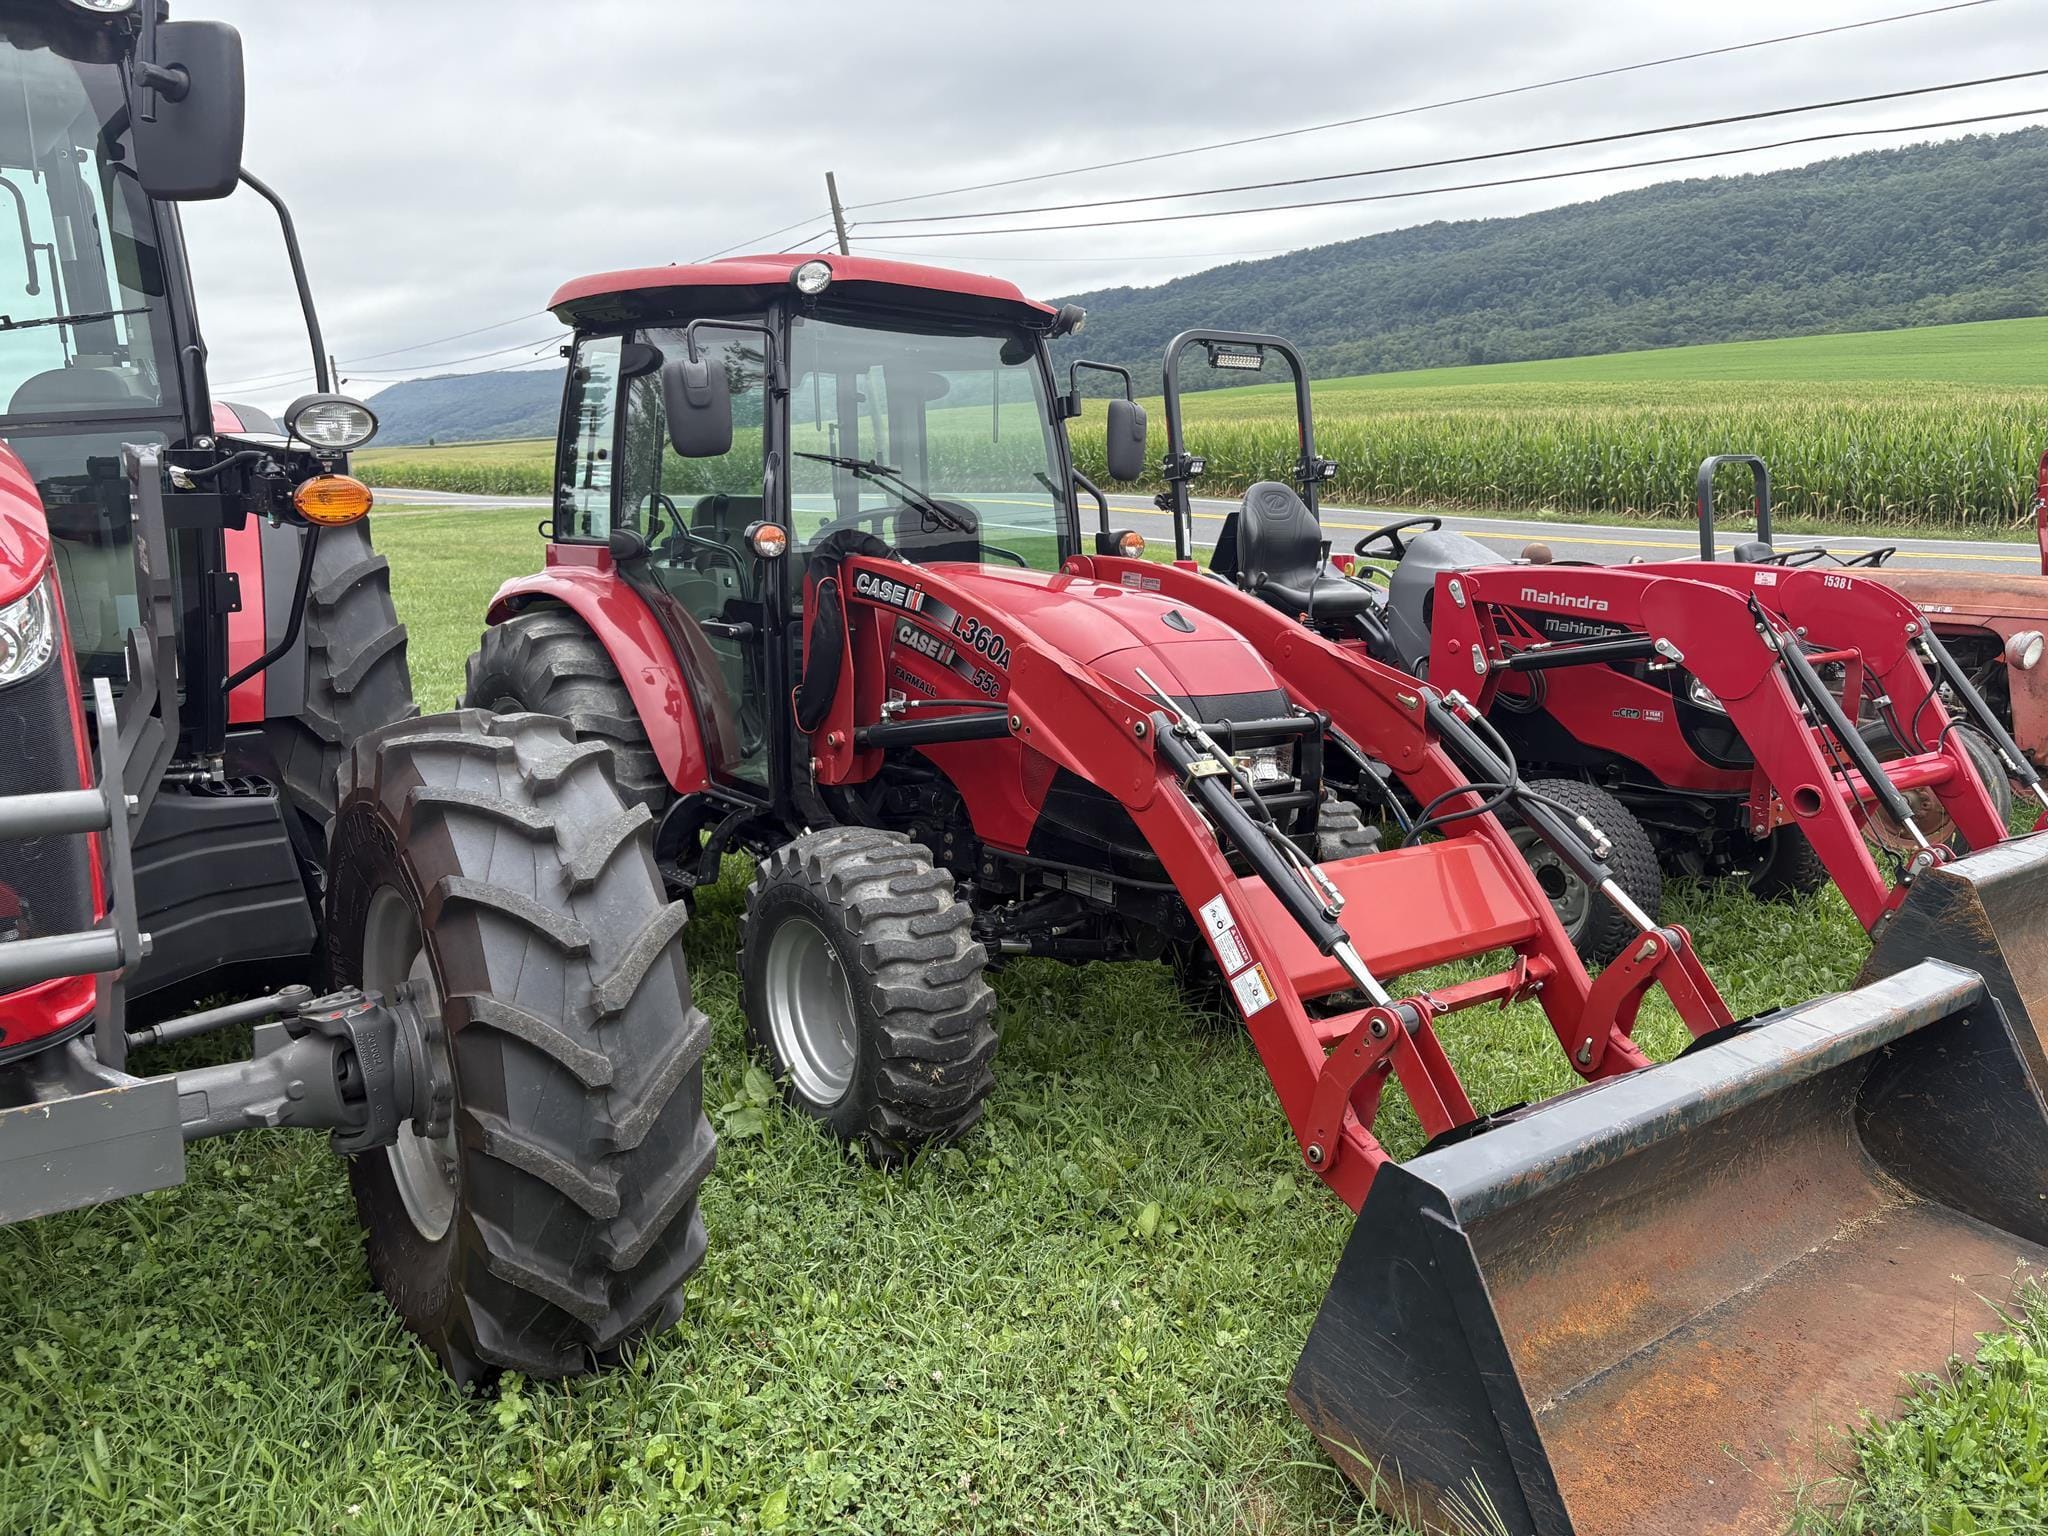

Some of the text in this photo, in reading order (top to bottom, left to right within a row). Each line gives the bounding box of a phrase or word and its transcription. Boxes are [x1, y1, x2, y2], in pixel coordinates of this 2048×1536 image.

[856, 573, 906, 606] CASE
[1823, 575, 1846, 589] 1538
[1520, 587, 1609, 611] Mahindra
[899, 625, 940, 660] CASE
[952, 613, 1012, 672] L360A
[1545, 619, 1621, 637] Mahindra
[894, 667, 937, 698] FARMALL
[972, 668, 1000, 698] 55C
[1234, 935, 1249, 961] DANGER
